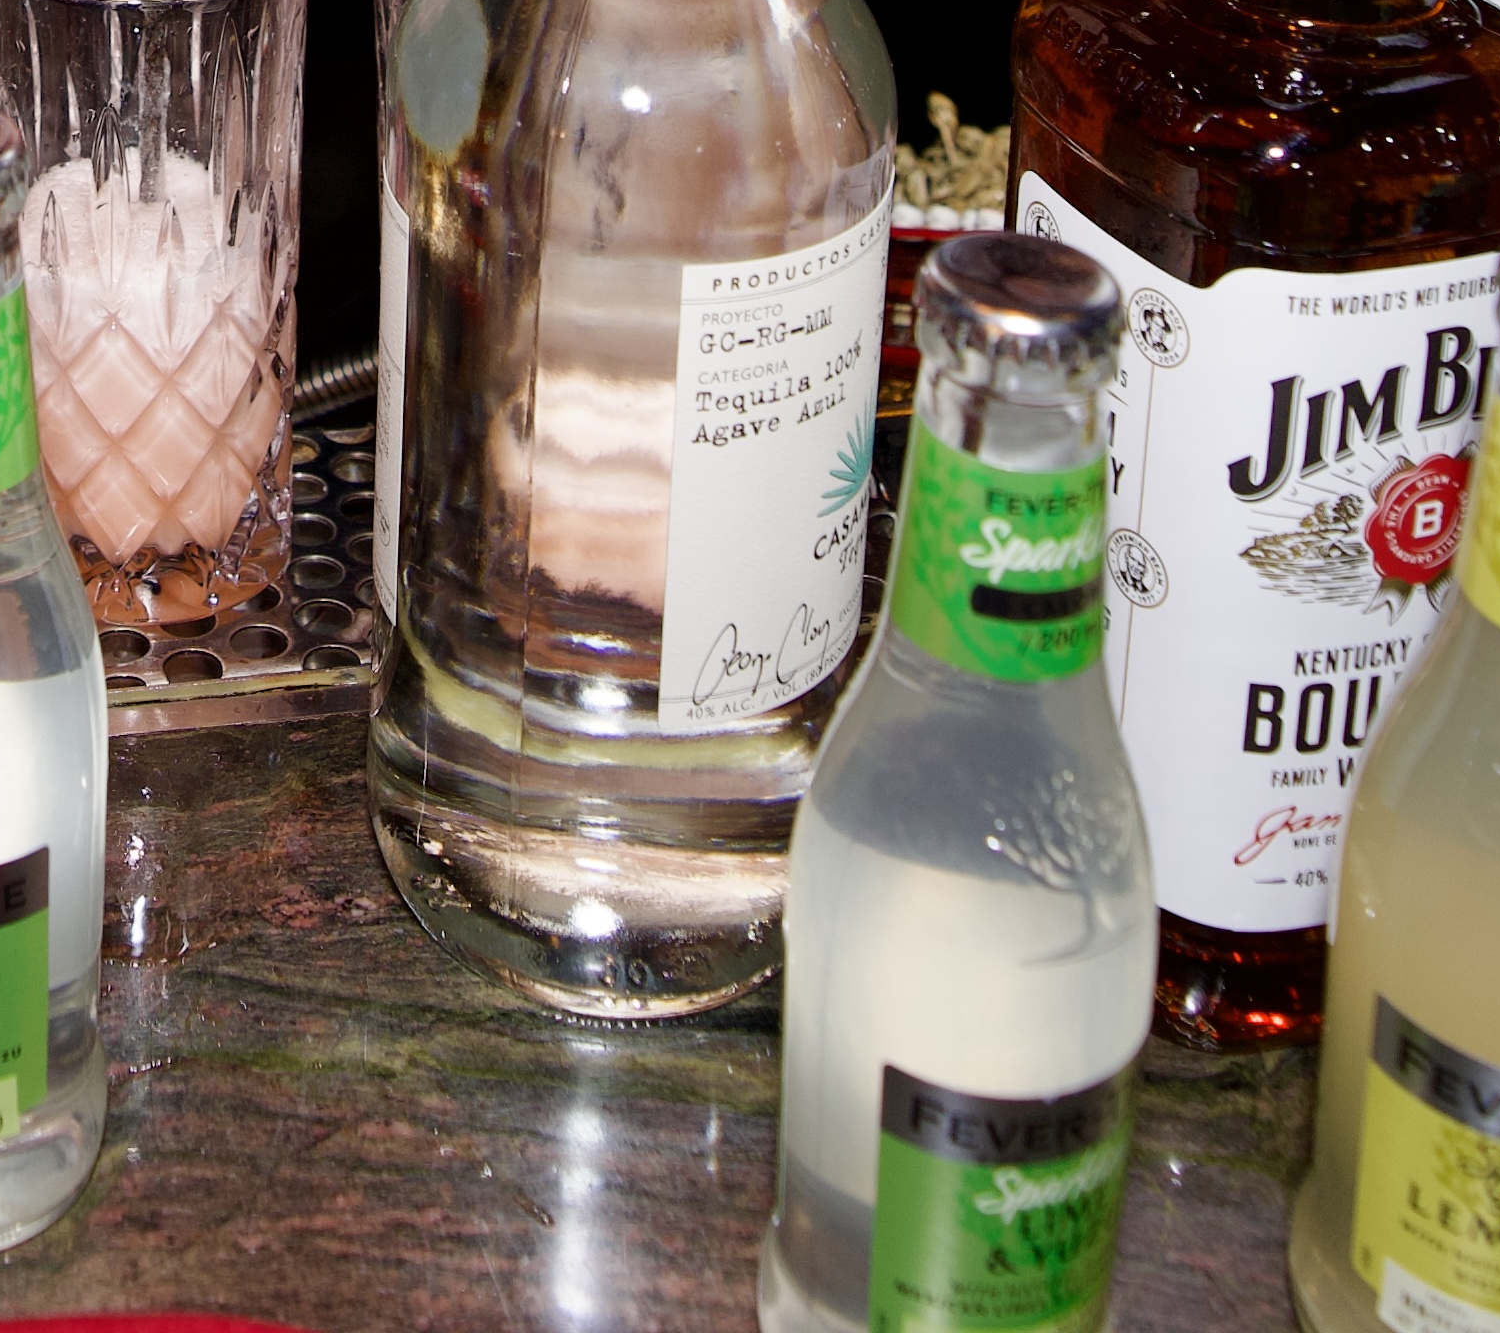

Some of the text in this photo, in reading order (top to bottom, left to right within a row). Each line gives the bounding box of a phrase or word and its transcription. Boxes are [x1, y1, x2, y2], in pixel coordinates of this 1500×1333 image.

[711, 244, 851, 293] PRODUCTOS
[701, 303, 785, 328] PROYECTO
[1288, 294, 1322, 316] THE
[1331, 291, 1409, 316] WORLD'S
[697, 358, 791, 387] CATEGORIA
[695, 375, 812, 414] Tequila
[691, 382, 847, 448] Agave Azul
[1411, 498, 1445, 540] B
[1294, 636, 1413, 678] KENTUCKY
[686, 704, 716, 721] 40%
[721, 696, 756, 716] ALC.
[1270, 766, 1330, 789] FAMILY
[1232, 804, 1343, 868] Jam
[1295, 868, 1330, 889] 40%
